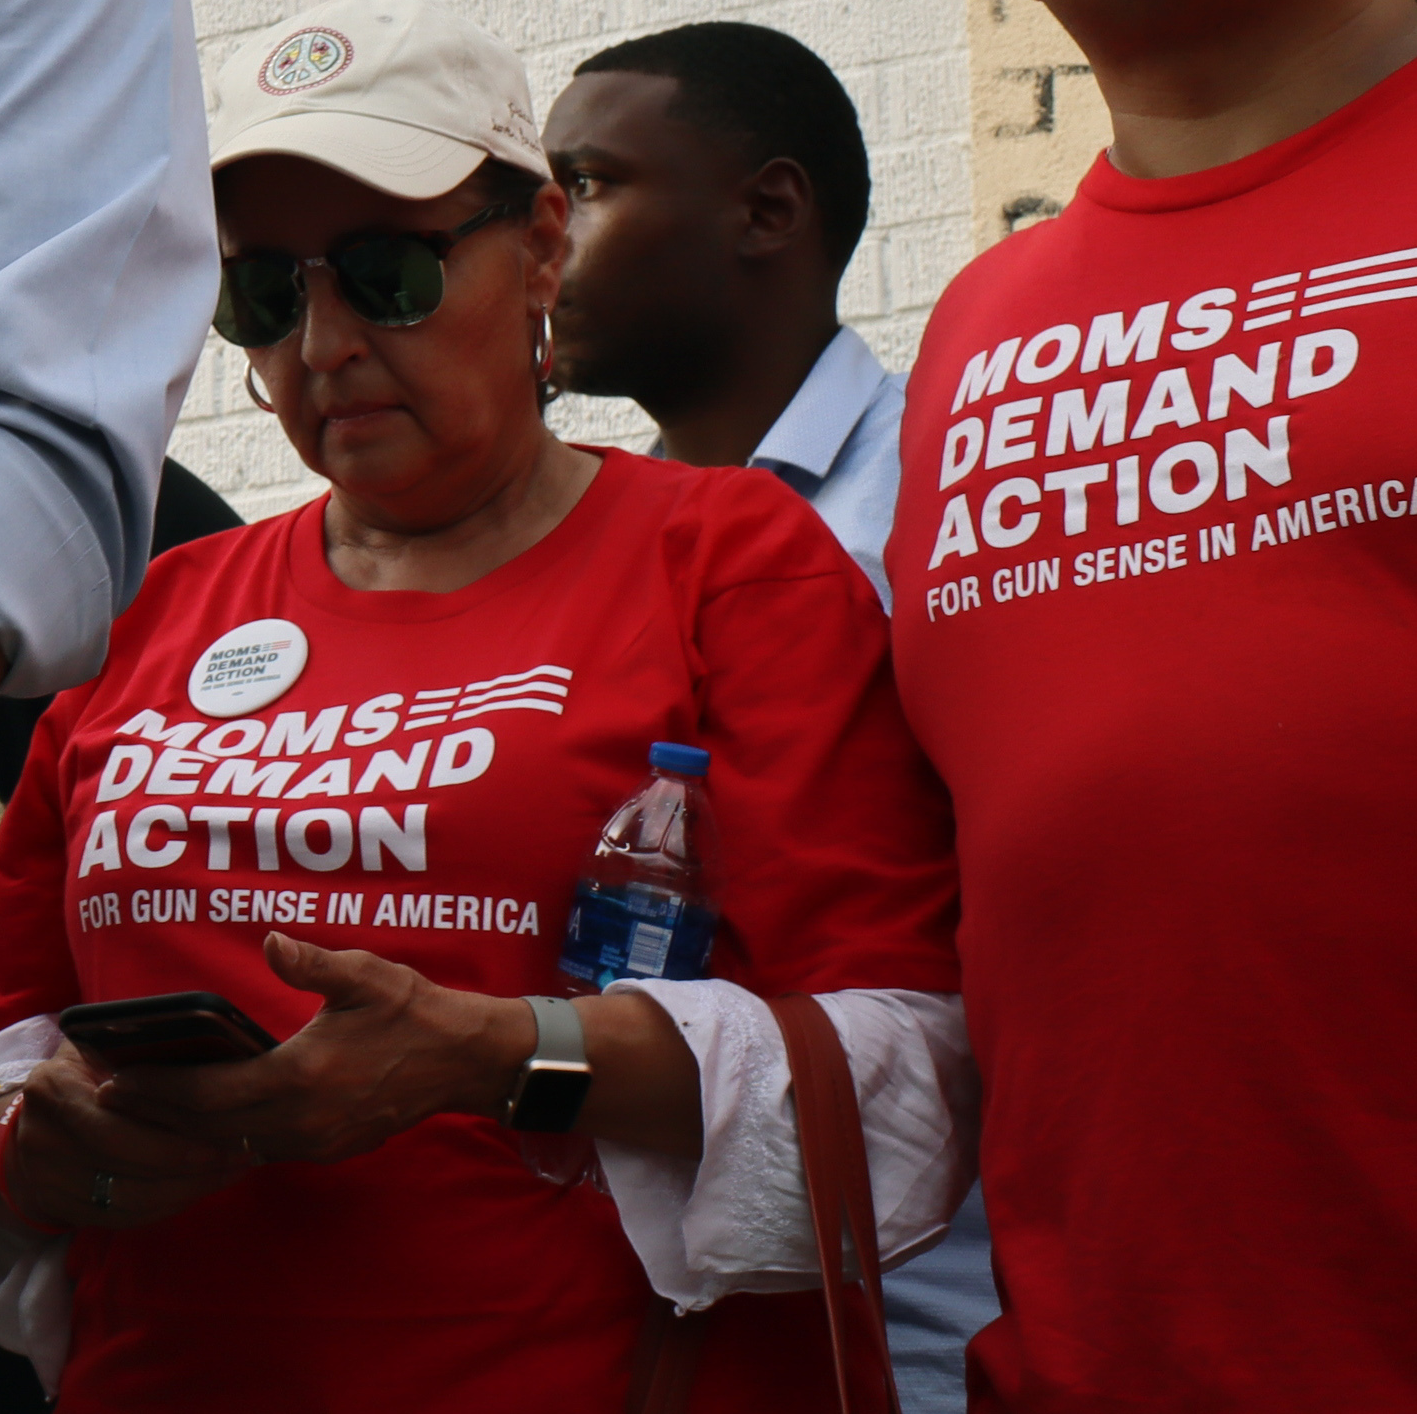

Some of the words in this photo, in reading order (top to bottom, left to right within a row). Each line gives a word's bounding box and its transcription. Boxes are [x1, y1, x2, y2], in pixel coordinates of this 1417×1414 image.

[950, 287, 1238, 416] MOMS
[938, 328, 1360, 492] DEMAND
[927, 415, 1293, 572] ACTION
[926, 575, 982, 623] FOR
[992, 556, 1061, 605] GUN
[1072, 534, 1189, 587] SENSE
[1198, 522, 1237, 563] IN
[1250, 476, 1417, 553] AMERIC
[202, 664, 267, 685] ACTION
[205, 652, 279, 674] DEMAND
[209, 643, 262, 662] MOMS
[94, 726, 497, 804] DEMAND
[115, 692, 405, 762] MOMS
[76, 802, 429, 879] ACTION
[77, 891, 121, 933] FOR
[130, 888, 198, 925] GUN
[208, 888, 320, 925] SENSE
[325, 891, 364, 926] IN
[373, 893, 540, 937] AMERICA
